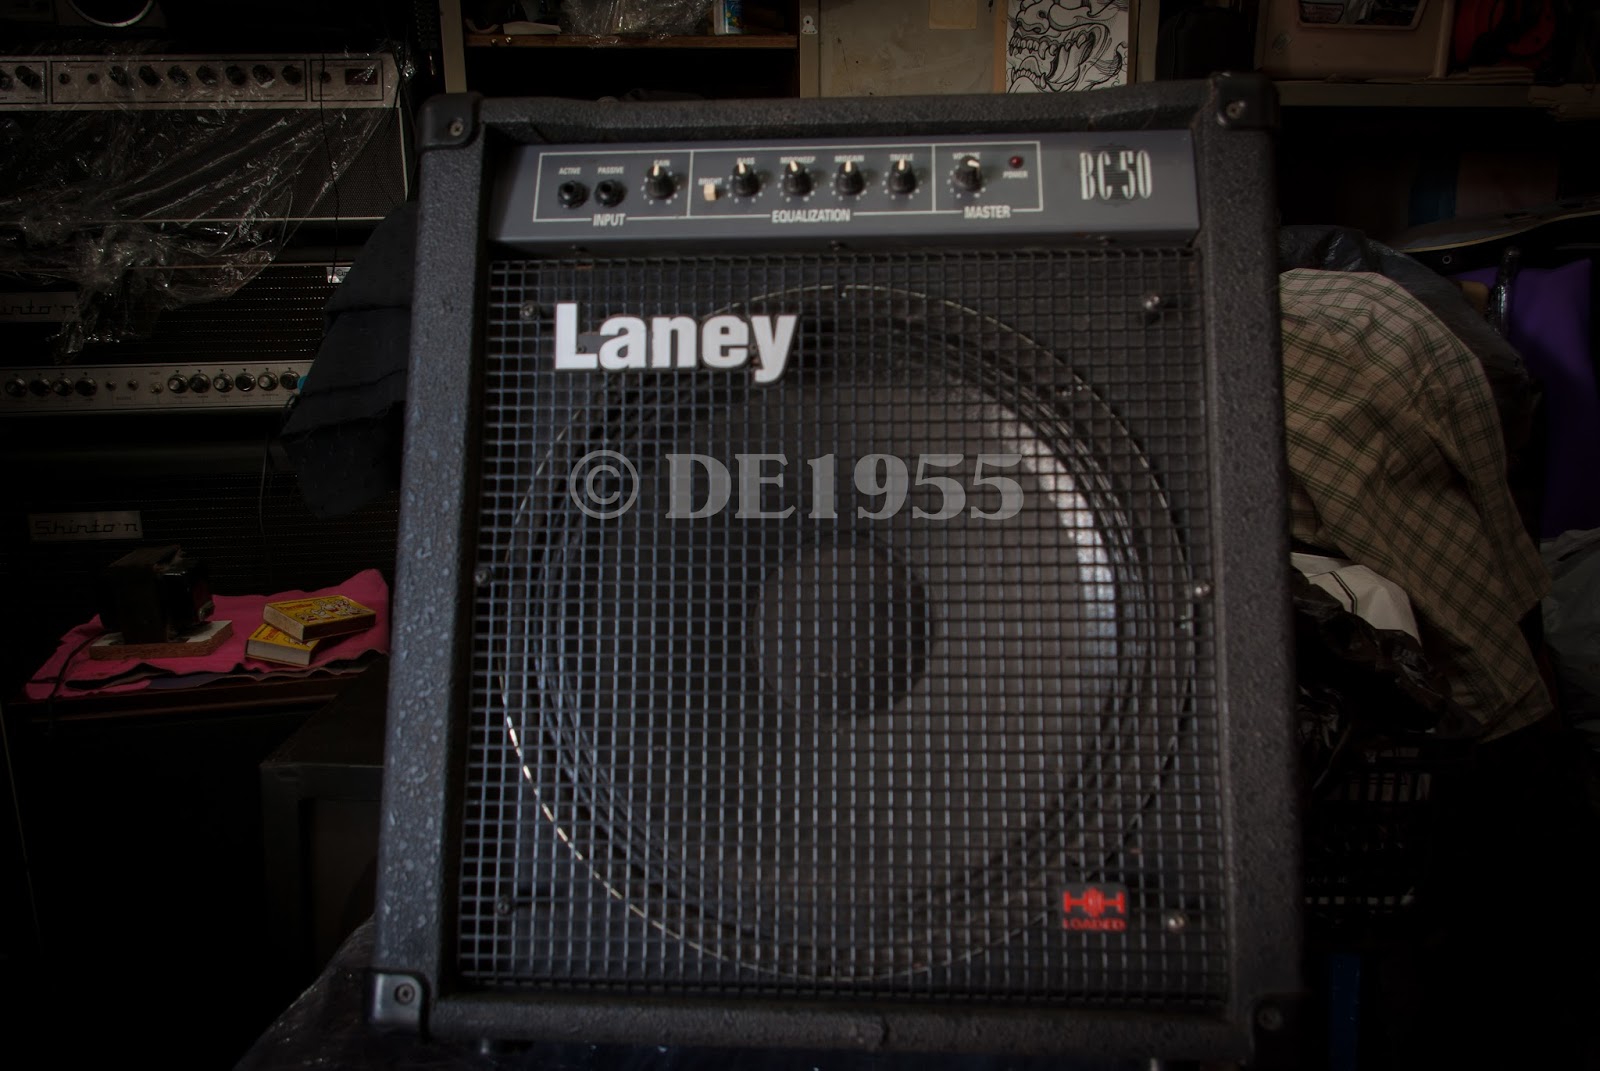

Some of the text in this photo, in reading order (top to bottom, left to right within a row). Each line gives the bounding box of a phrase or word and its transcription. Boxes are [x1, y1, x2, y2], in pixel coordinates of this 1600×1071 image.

[558, 166, 581, 175] ACTIVE
[597, 166, 624, 175] PASSIVE
[1002, 170, 1028, 179] POWER
[1080, 149, 1153, 200] BC 50
[771, 208, 851, 224] EQUALIZATION
[963, 205, 1011, 219] MASTER
[593, 213, 626, 227] INPUT
[555, 302, 798, 384] Laney
[1062, 917, 1127, 931] LOADED
